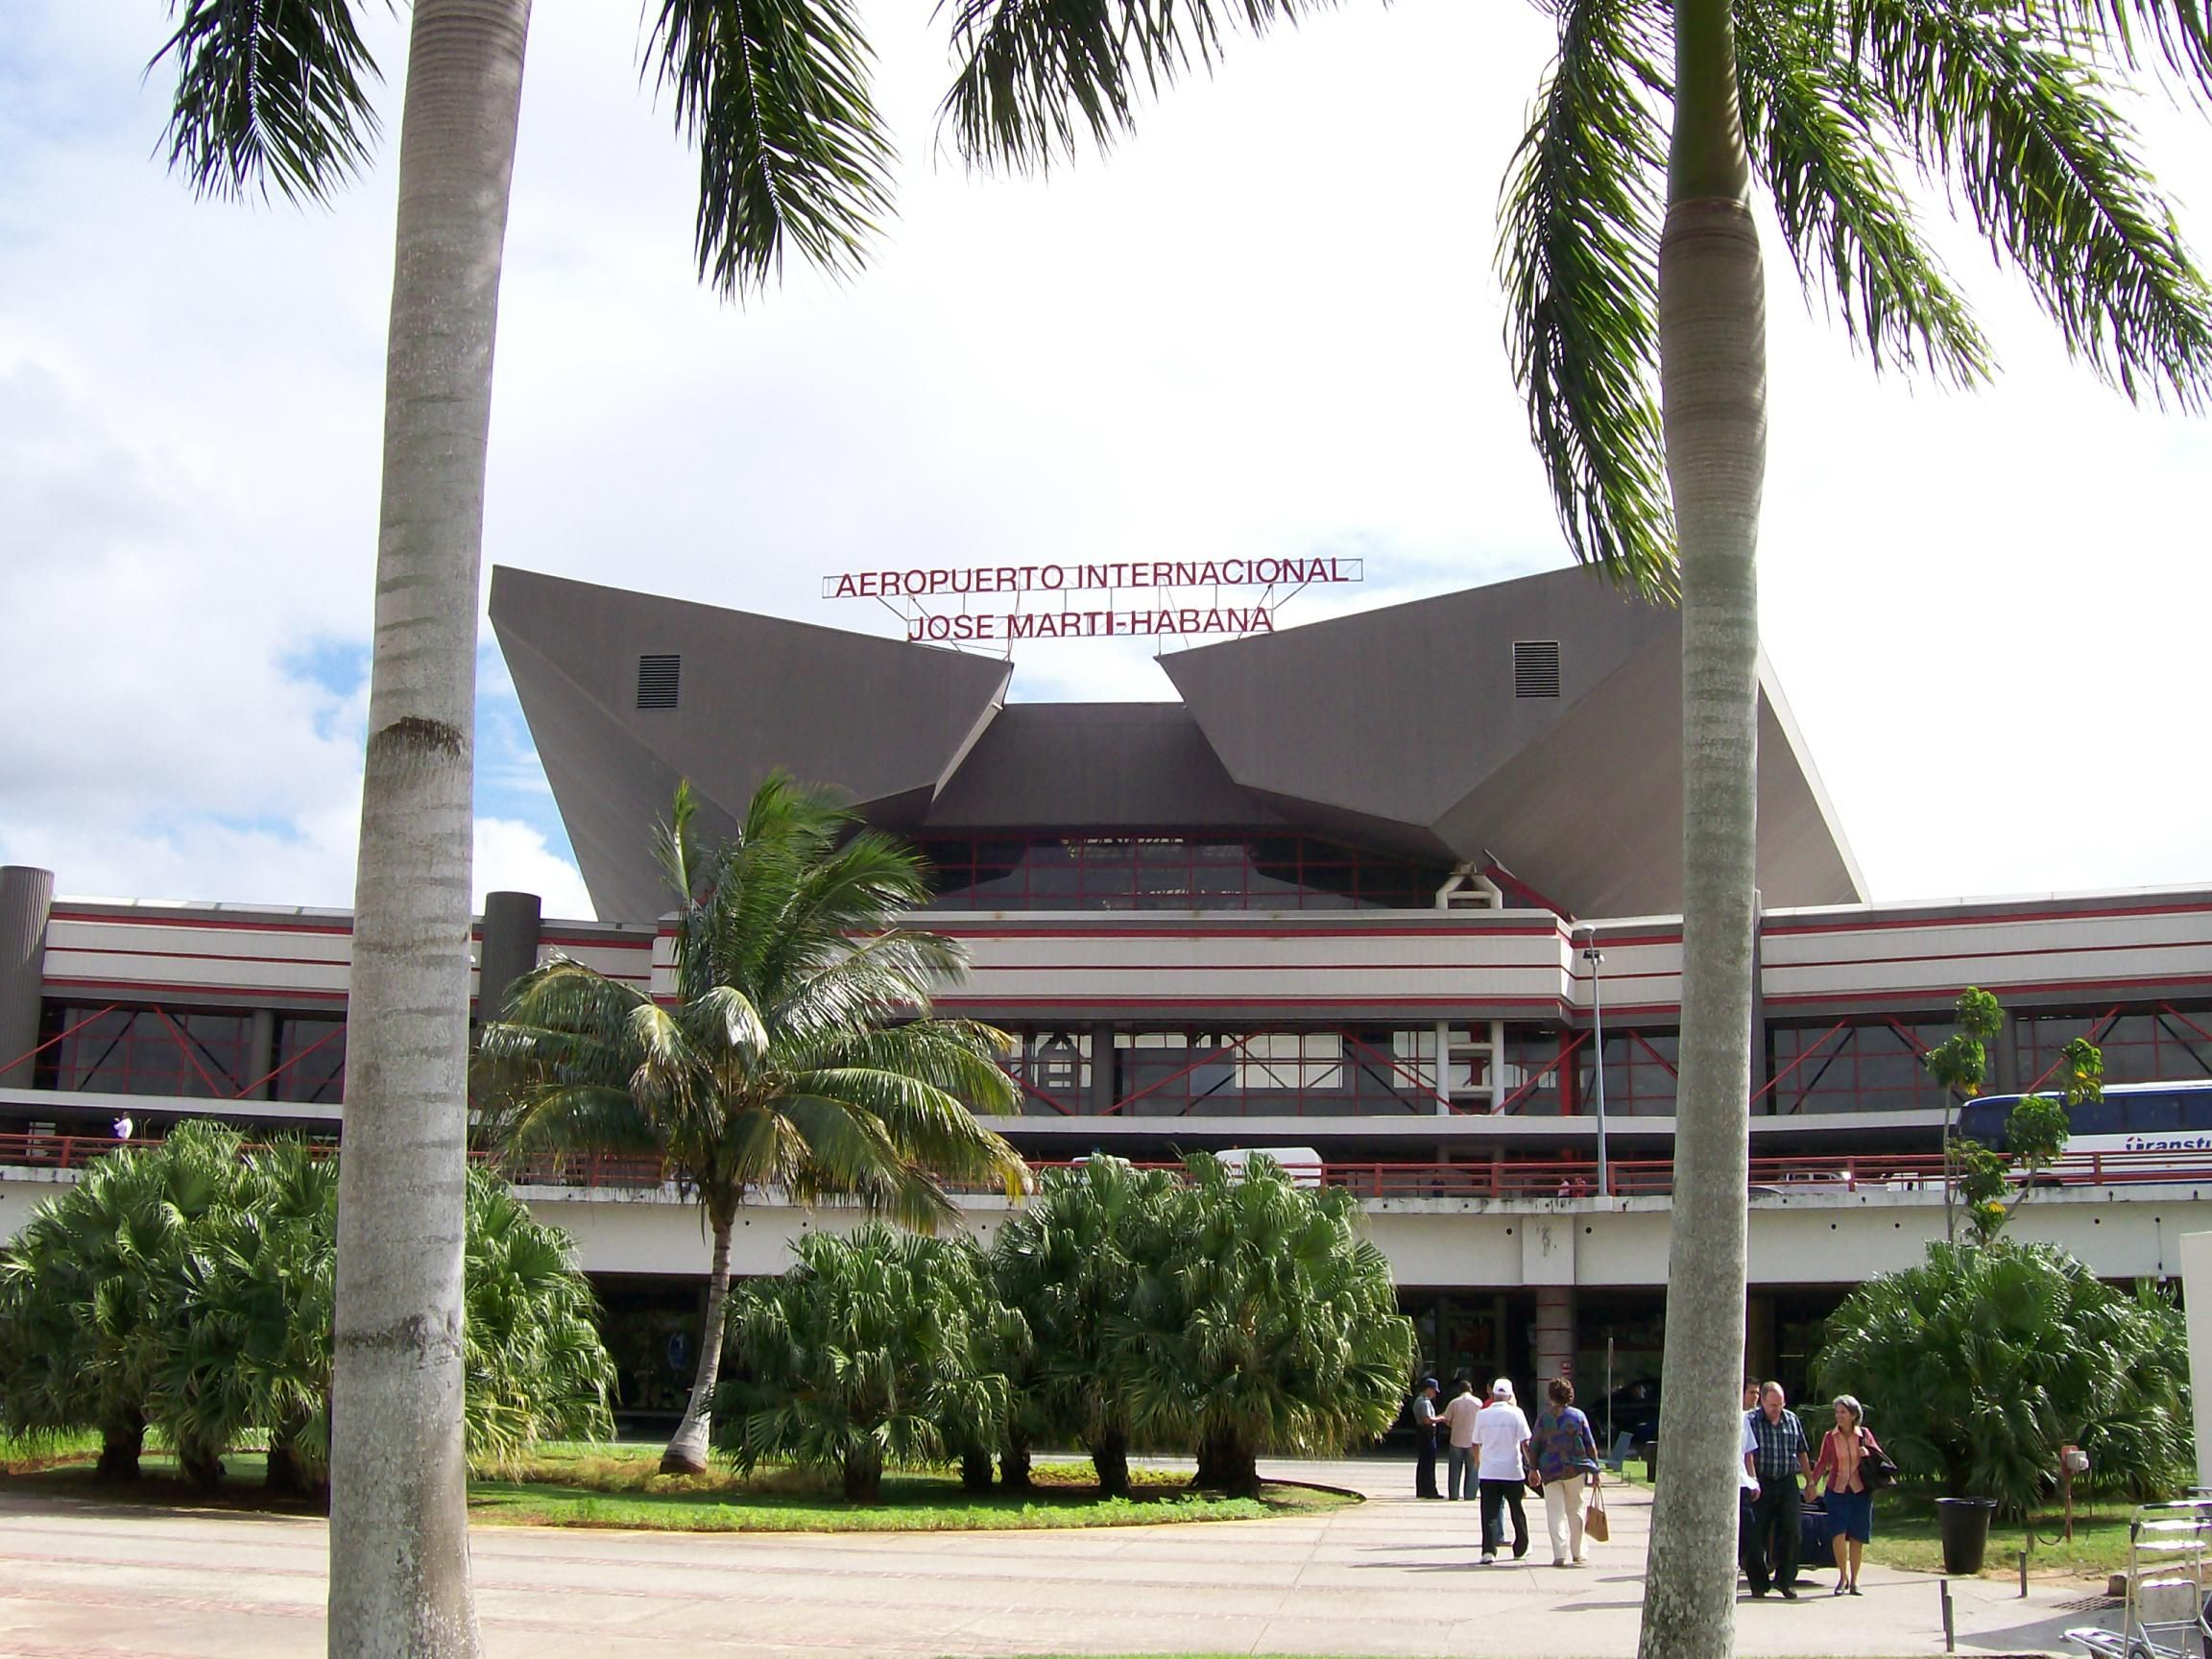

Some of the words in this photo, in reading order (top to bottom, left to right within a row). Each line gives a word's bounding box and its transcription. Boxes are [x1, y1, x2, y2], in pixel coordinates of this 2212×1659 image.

[835, 565, 1064, 597] AEROPUERTO
[1077, 557, 1349, 589] INTERNACIONAL
[908, 614, 995, 641] JOSE
[1008, 607, 1274, 638] MARTI-HABANA
